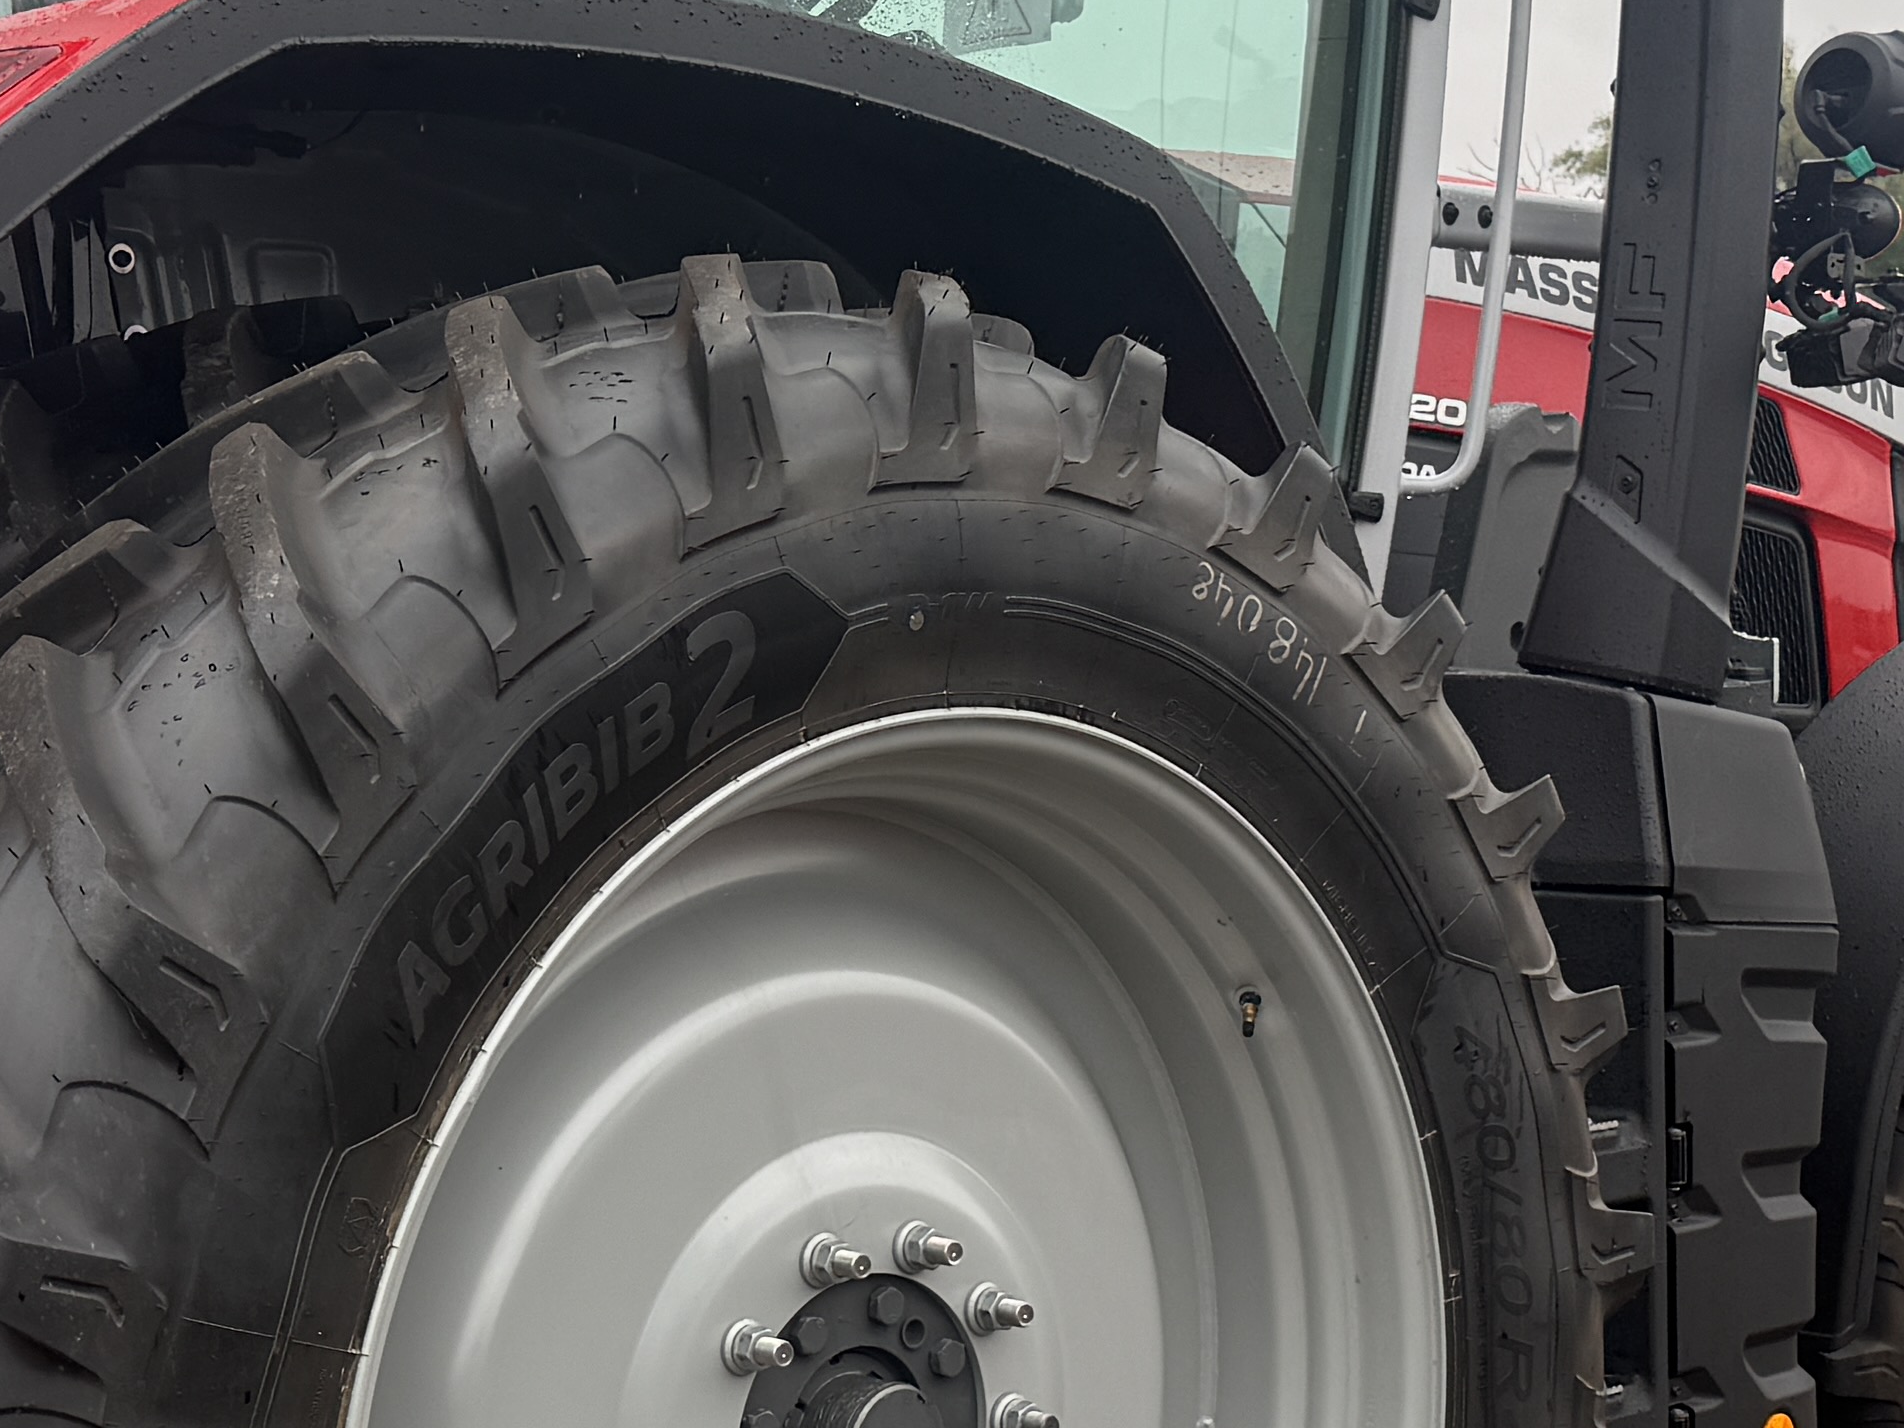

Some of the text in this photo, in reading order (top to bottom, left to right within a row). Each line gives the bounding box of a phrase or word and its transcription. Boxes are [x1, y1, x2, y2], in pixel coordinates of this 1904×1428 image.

[1454, 248, 1599, 314] MASS
[1600, 240, 1670, 412] MF
[396, 609, 757, 1050] AGRIBIB 2
